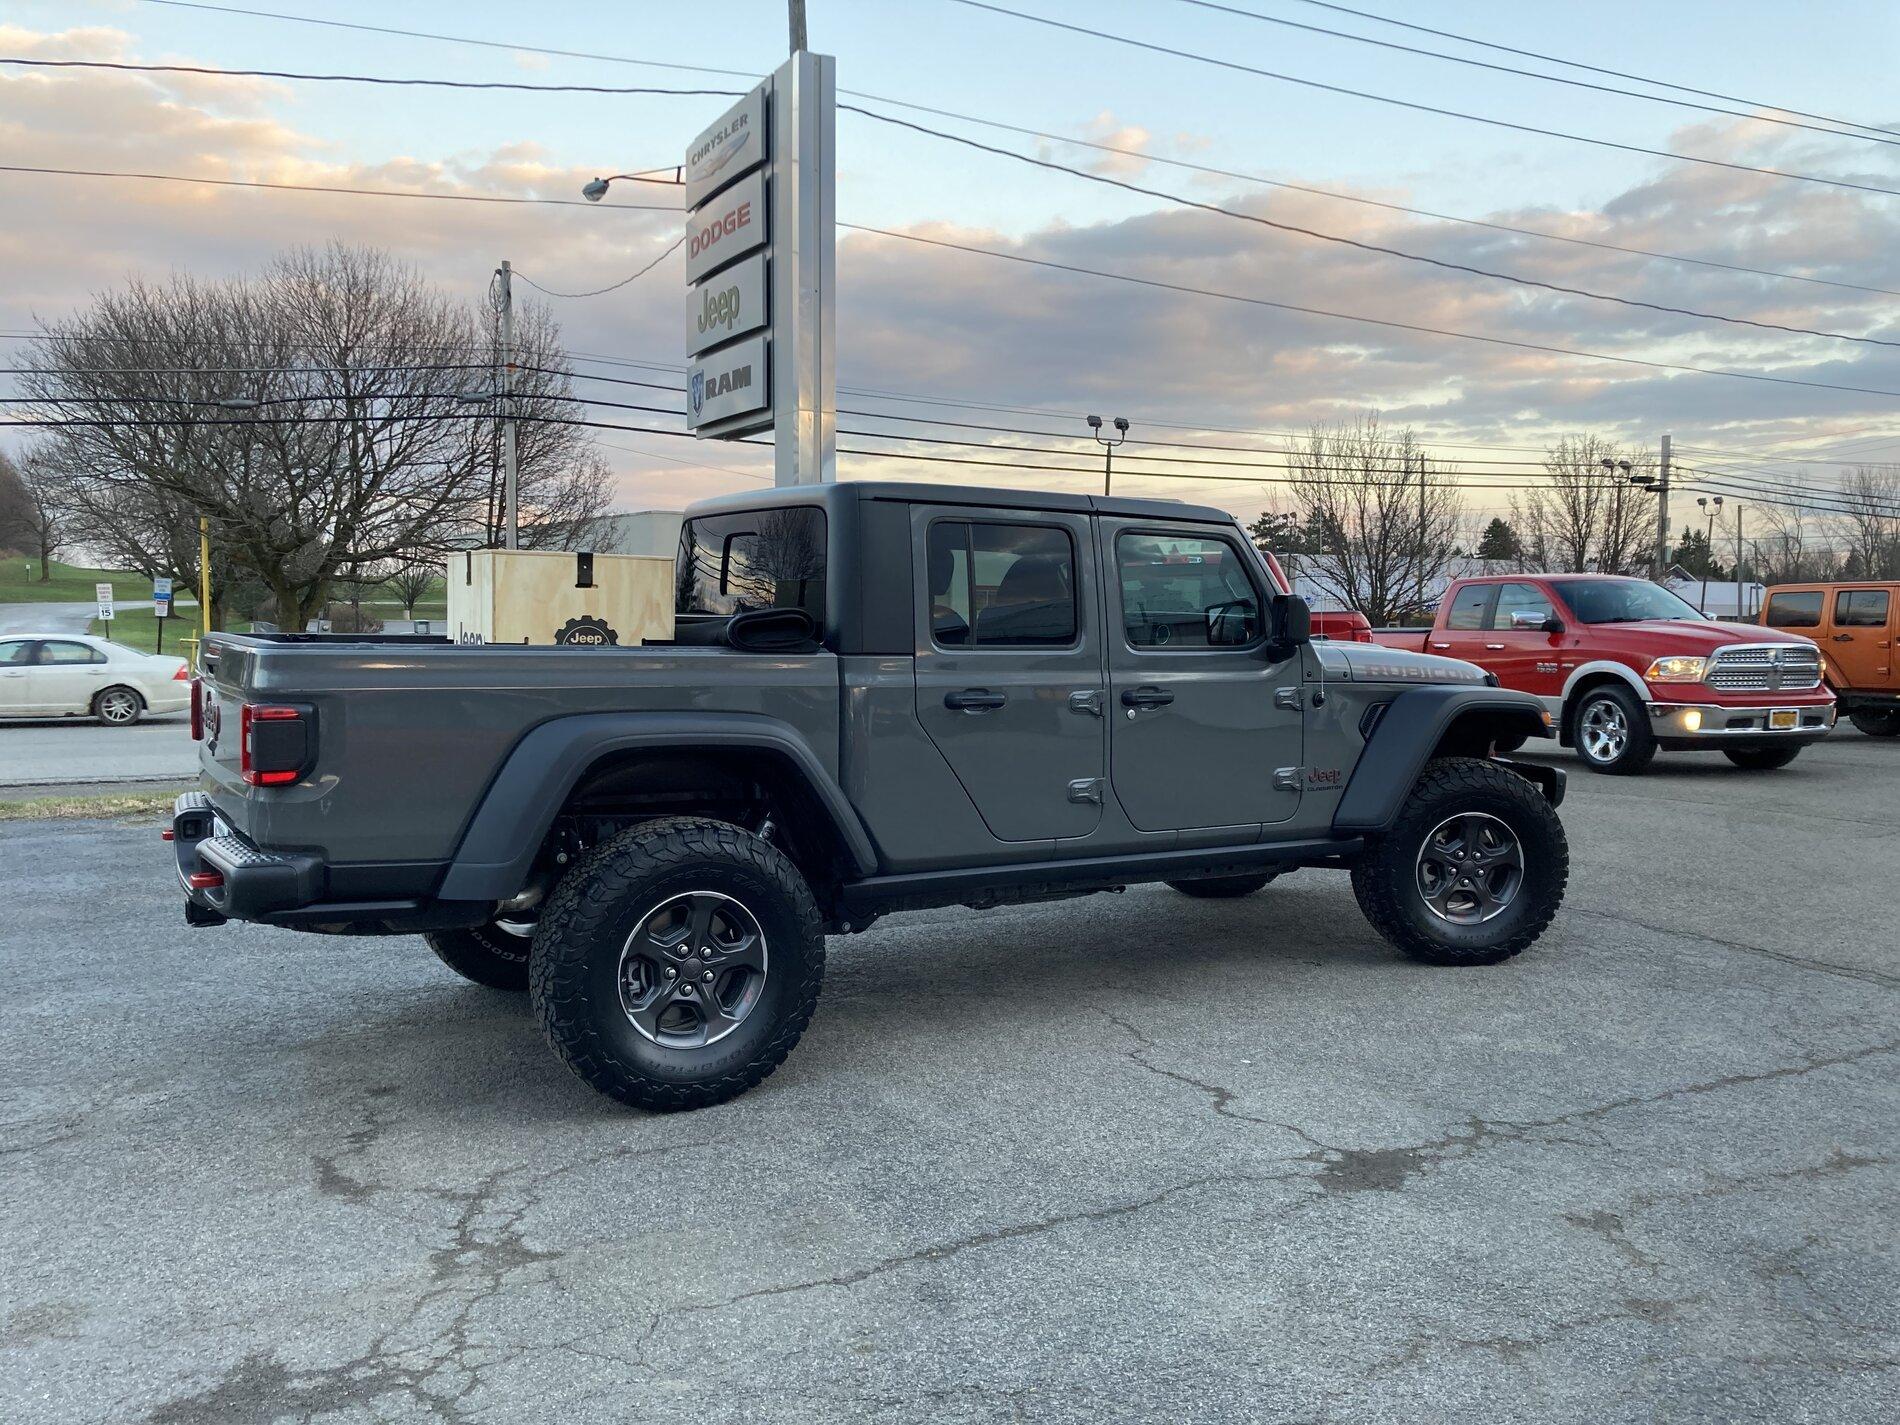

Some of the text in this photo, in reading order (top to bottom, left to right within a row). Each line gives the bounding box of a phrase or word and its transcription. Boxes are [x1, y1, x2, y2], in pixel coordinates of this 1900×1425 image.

[690, 113, 749, 166] CHRYSLER
[690, 202, 751, 260] DODGE
[697, 284, 740, 335] Jeep
[705, 365, 752, 401] RAM
[101, 609, 111, 617] 15
[570, 632, 603, 645] Jeep
[1308, 766, 1342, 784] Jeep
